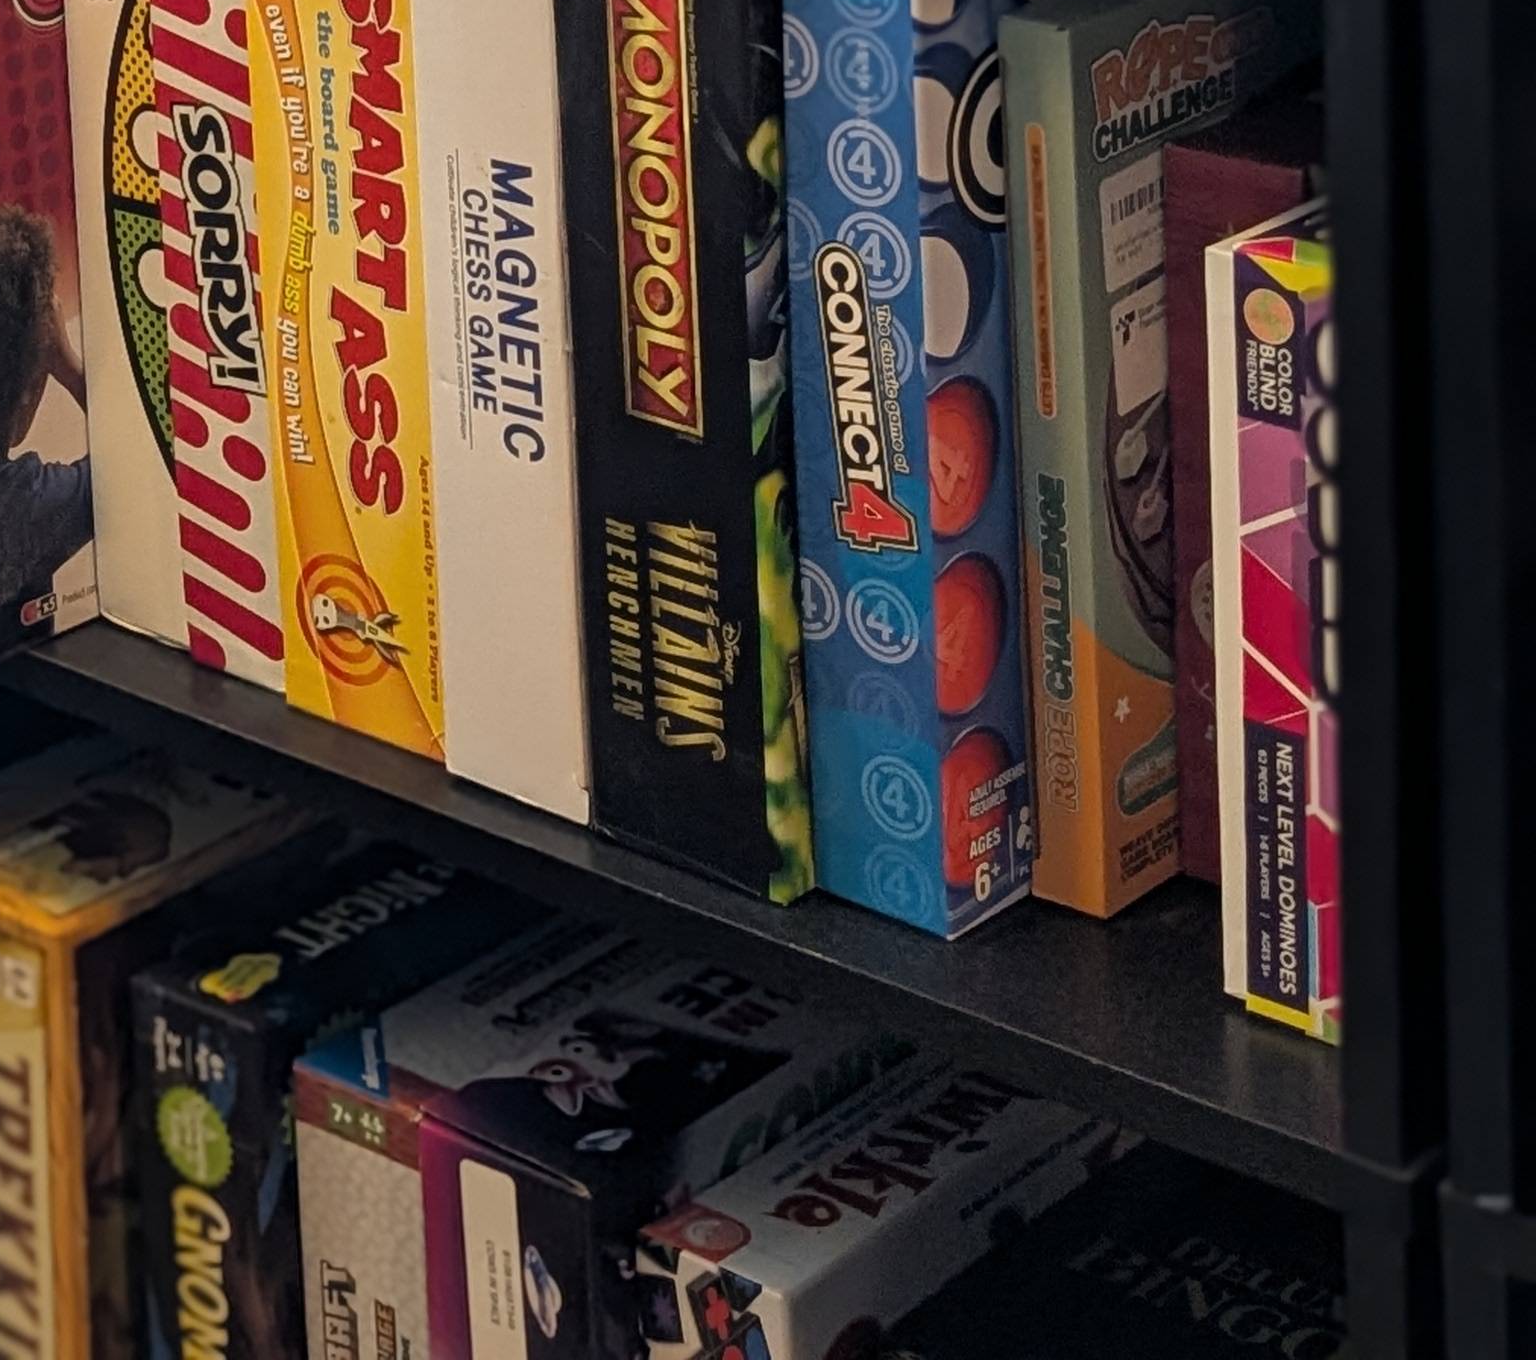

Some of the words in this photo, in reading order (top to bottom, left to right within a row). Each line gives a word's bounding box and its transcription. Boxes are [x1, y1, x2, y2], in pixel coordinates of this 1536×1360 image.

[264, 3, 294, 62] even
[317, 9, 332, 59] the
[283, 63, 306, 89] if
[282, 95, 314, 175] you're
[319, 65, 336, 154] board
[1094, 73, 1235, 162] CHALLENGE
[295, 181, 310, 200] a
[322, 157, 341, 237] game
[172, 106, 266, 394] SORRY!
[289, 210, 317, 273] dumb
[447, 154, 456, 203] Cultivate
[453, 296, 463, 340] thinking
[463, 187, 493, 302] CHESS
[282, 271, 302, 315] ass
[488, 158, 546, 463] MAGNETIC
[875, 304, 891, 338] The
[276, 317, 298, 363] you
[469, 316, 498, 416] GAME
[818, 247, 884, 489] CONNECT
[880, 337, 900, 398] classic
[282, 364, 302, 410] can
[329, 282, 406, 518] ASS
[1245, 338, 1259, 410] FRIENDLY
[1259, 341, 1278, 413] BLIND
[1277, 347, 1293, 417] COLOR
[284, 411, 317, 466] win!
[885, 399, 907, 452] game
[420, 455, 431, 494] Ages
[893, 452, 910, 475] of
[423, 519, 434, 550] and
[835, 484, 918, 552] 4
[424, 553, 435, 577] Up
[1037, 471, 1074, 702] CHALLENGE
[604, 516, 645, 723] HENCHMEN
[646, 517, 727, 763] VILLAINS
[429, 643, 440, 704] Players
[1045, 704, 1078, 810] ROPE
[1258, 764, 1269, 804] PIECES
[1275, 741, 1294, 803] NEXT
[969, 828, 1002, 859] AGES
[1276, 804, 1294, 871] LEVEL
[974, 860, 1002, 903] 6+
[1259, 852, 1271, 900] PLAYERS
[1261, 929, 1272, 962] AGES
[1277, 874, 1297, 996] DOMINOES
